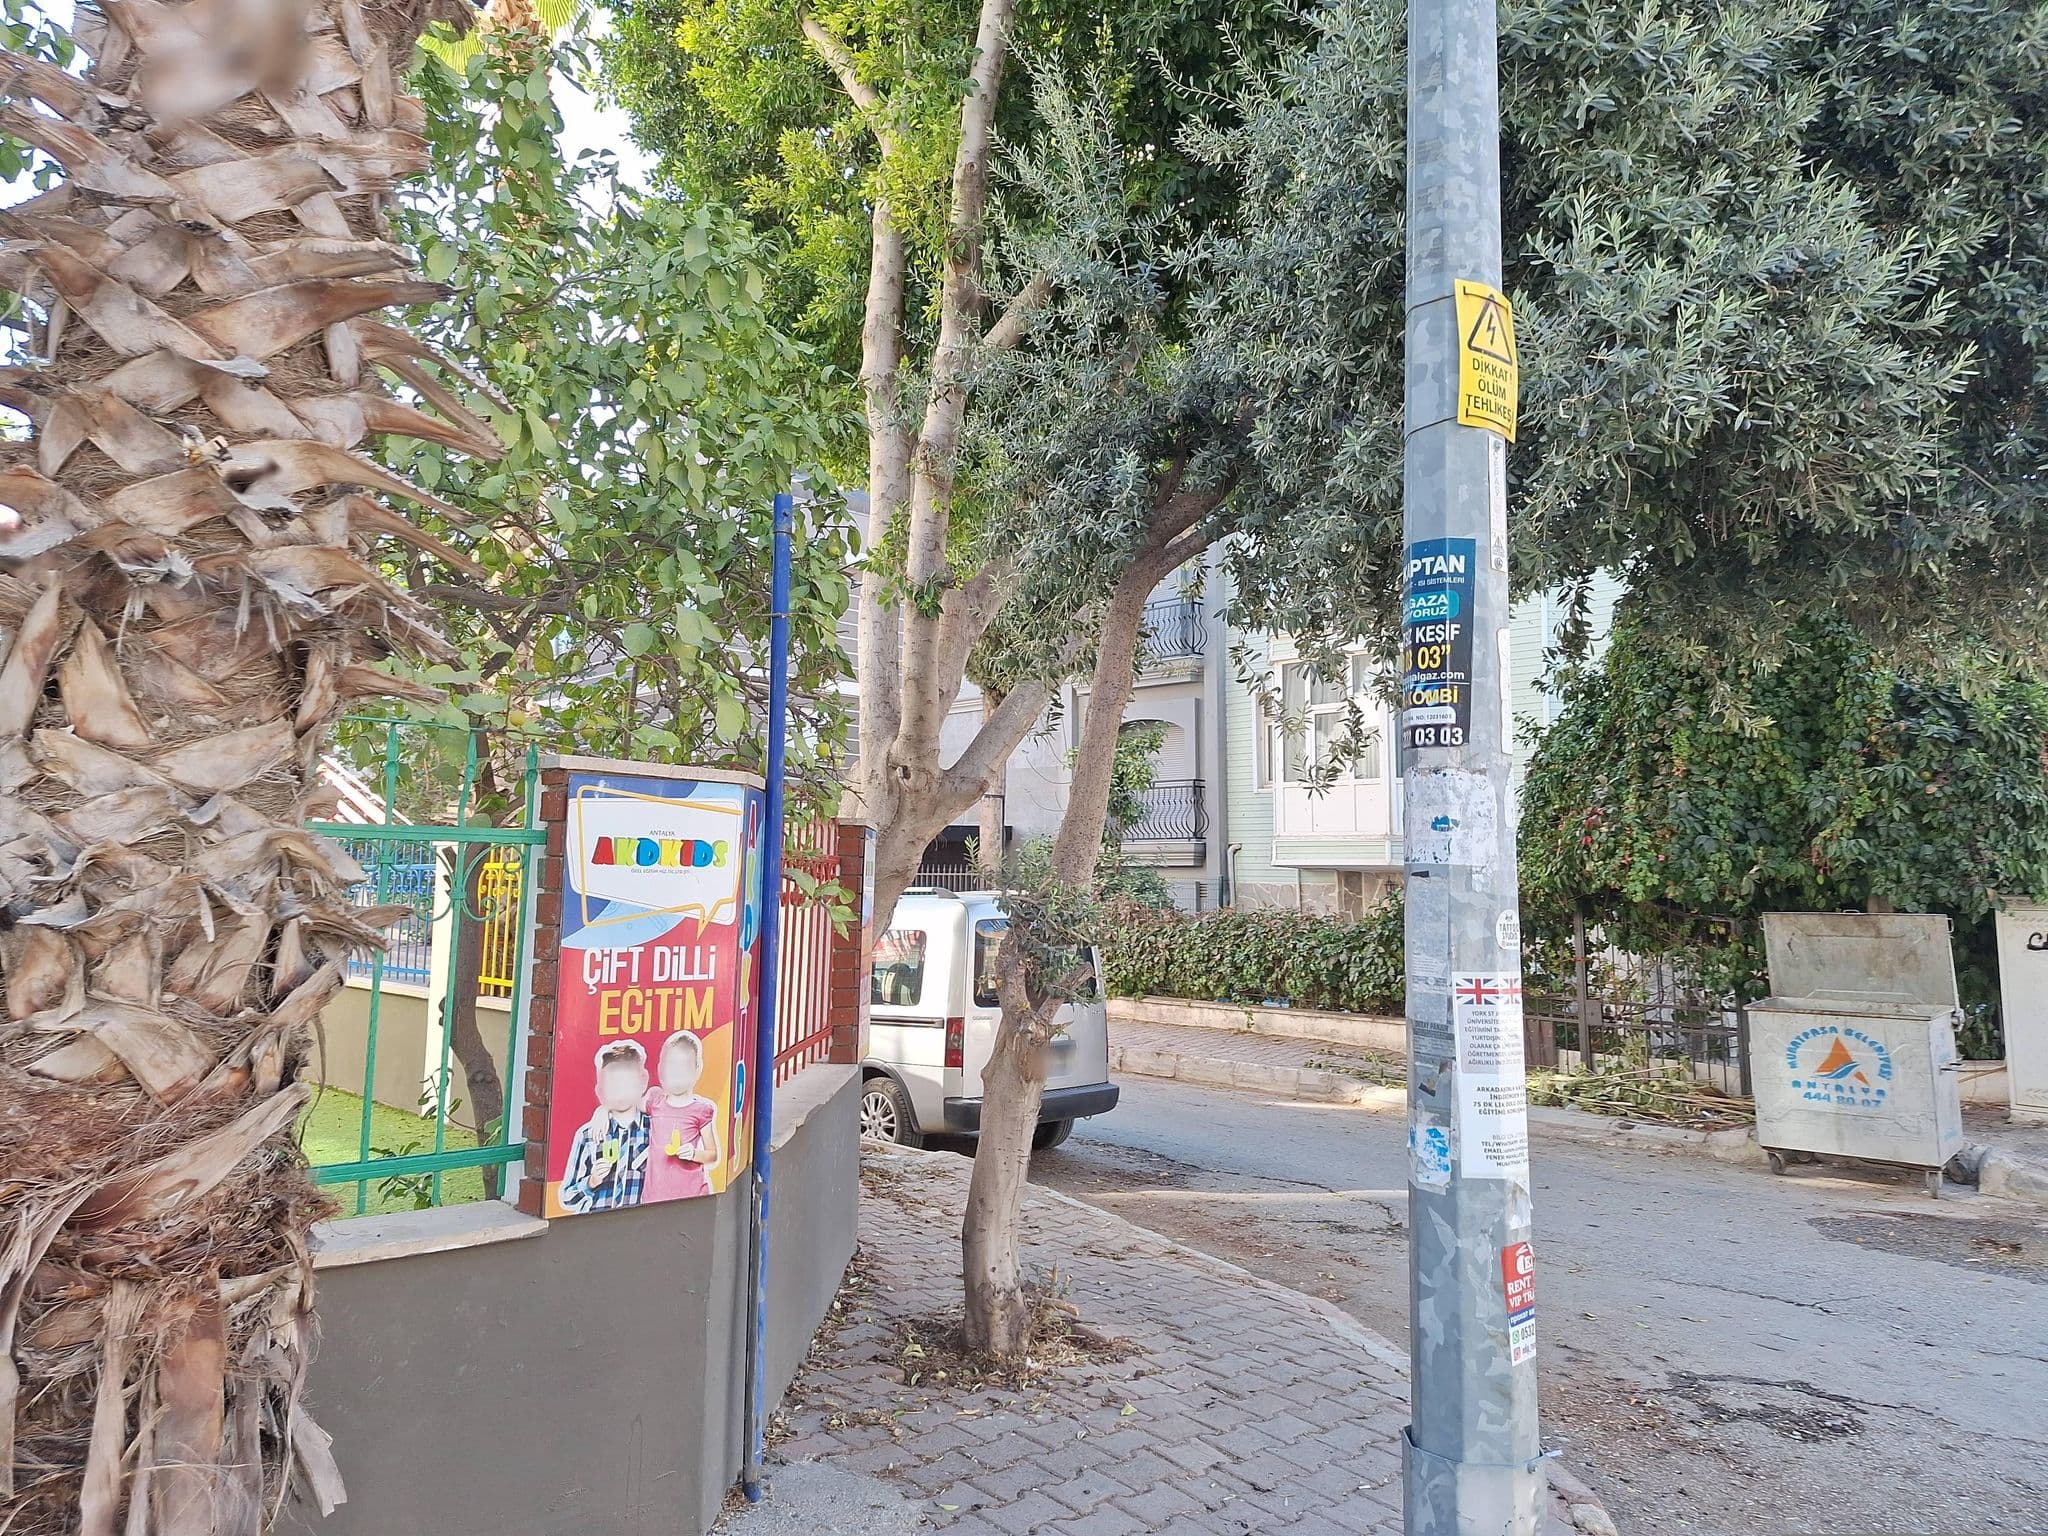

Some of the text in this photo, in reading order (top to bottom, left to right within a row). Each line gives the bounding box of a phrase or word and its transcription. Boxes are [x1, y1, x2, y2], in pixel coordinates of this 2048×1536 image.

[1478, 375, 1506, 400] ÖLÜM
[1403, 555, 1465, 584] PTAN
[1409, 594, 1449, 609] GAZA
[1415, 622, 1461, 643] KEŞİF
[1415, 727, 1435, 746] 03
[1440, 726, 1463, 746] 03
[591, 836, 729, 868] AKDKIDS
[583, 944, 717, 995] ÇİFT DİLLİ
[598, 985, 714, 1036] EĞİTİM
[1803, 1092, 1831, 1102] 444
[1507, 1275, 1532, 1295] RENT
[1509, 1295, 1523, 1308] VIP
